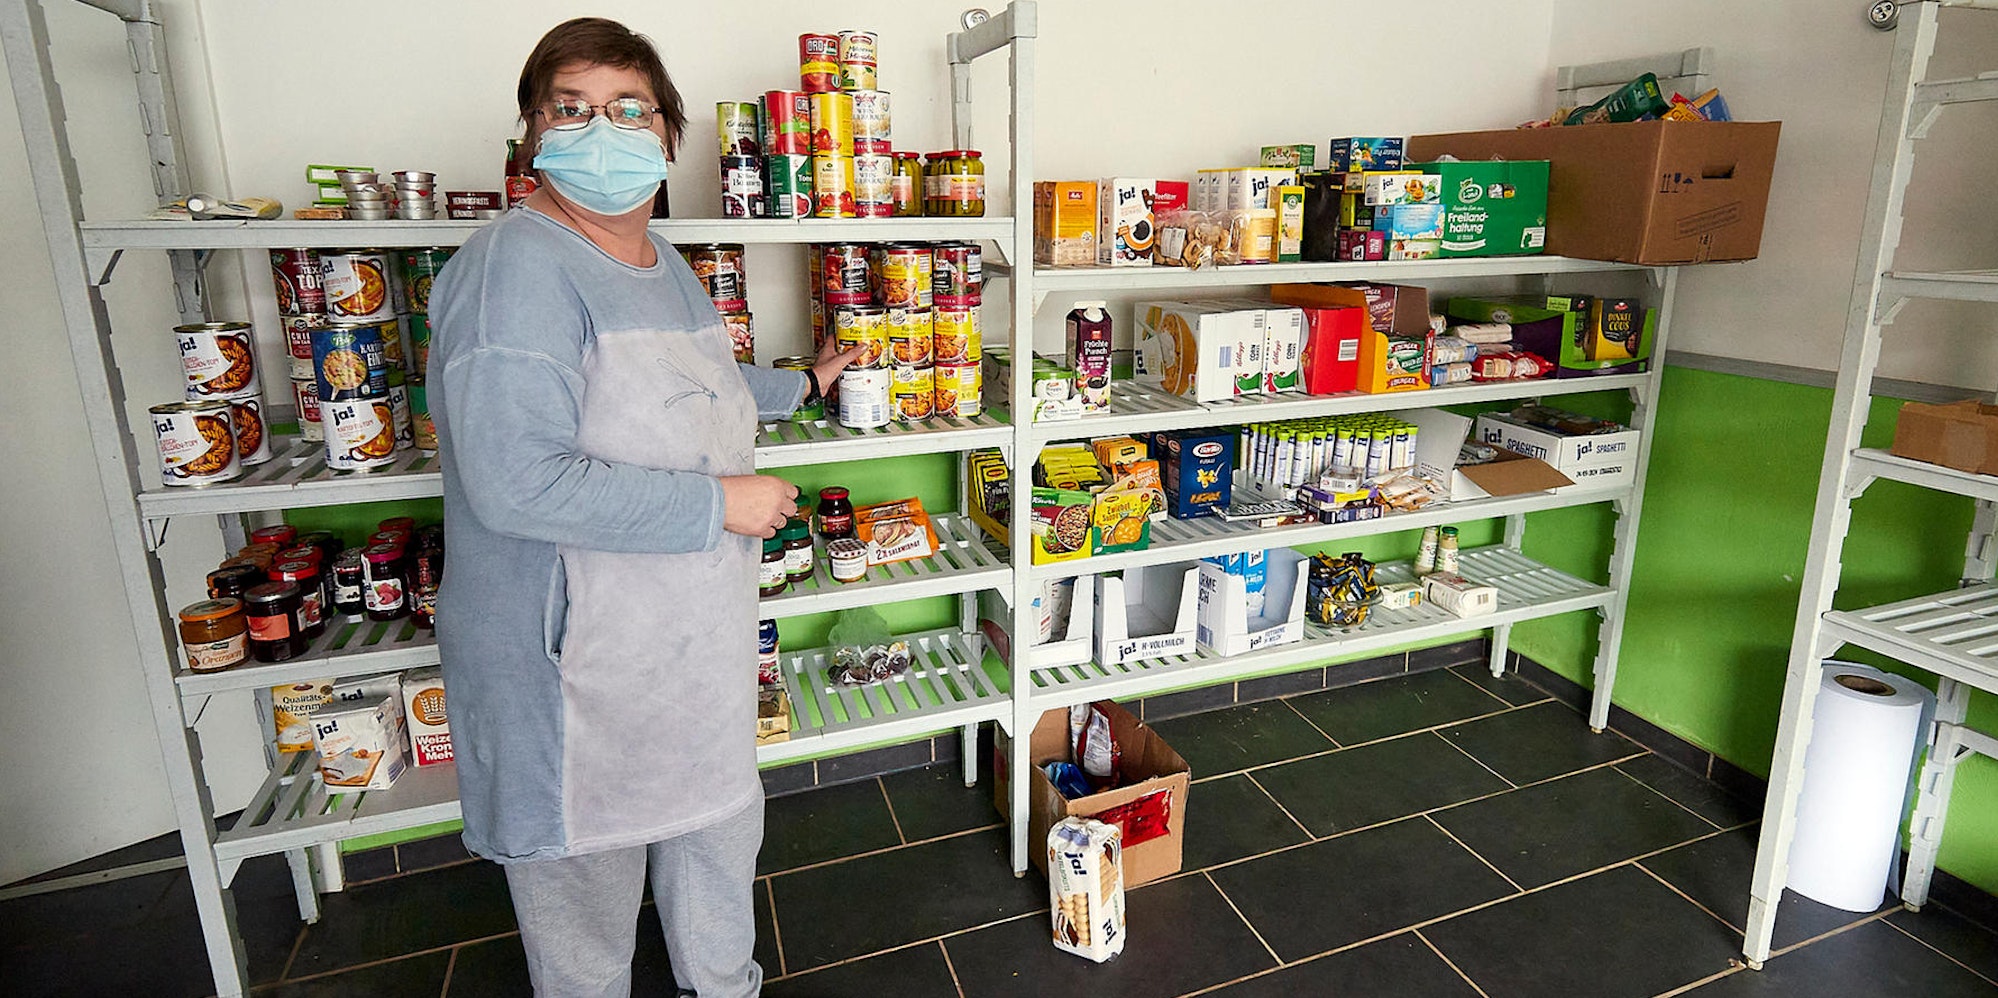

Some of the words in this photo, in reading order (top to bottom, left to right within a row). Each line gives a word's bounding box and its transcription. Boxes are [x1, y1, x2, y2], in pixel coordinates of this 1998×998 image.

[1252, 176, 1268, 197] ja!
[1382, 178, 1393, 190] ja!
[1119, 186, 1136, 205] ja!
[1447, 212, 1488, 224] Freiland-
[1448, 223, 1484, 234] haltung
[178, 337, 197, 356] ja!
[332, 406, 355, 426] ja!
[154, 418, 175, 438] ja!
[1484, 428, 1502, 444] ja!
[1506, 438, 1547, 460] SPAGHETTI
[1576, 441, 1592, 460] ja!
[1596, 442, 1626, 454] SPAGHETTI
[1251, 551, 1261, 563] ja!
[1119, 642, 1136, 661] ja!
[1142, 638, 1184, 650] H-VOLLMILCH
[1250, 636, 1262, 649] ja!
[274, 700, 332, 713] Weizenm
[282, 695, 326, 704] Qualitäts-
[316, 720, 339, 740] ja!
[1064, 851, 1087, 876] ja!
[1102, 918, 1117, 946] ja!
